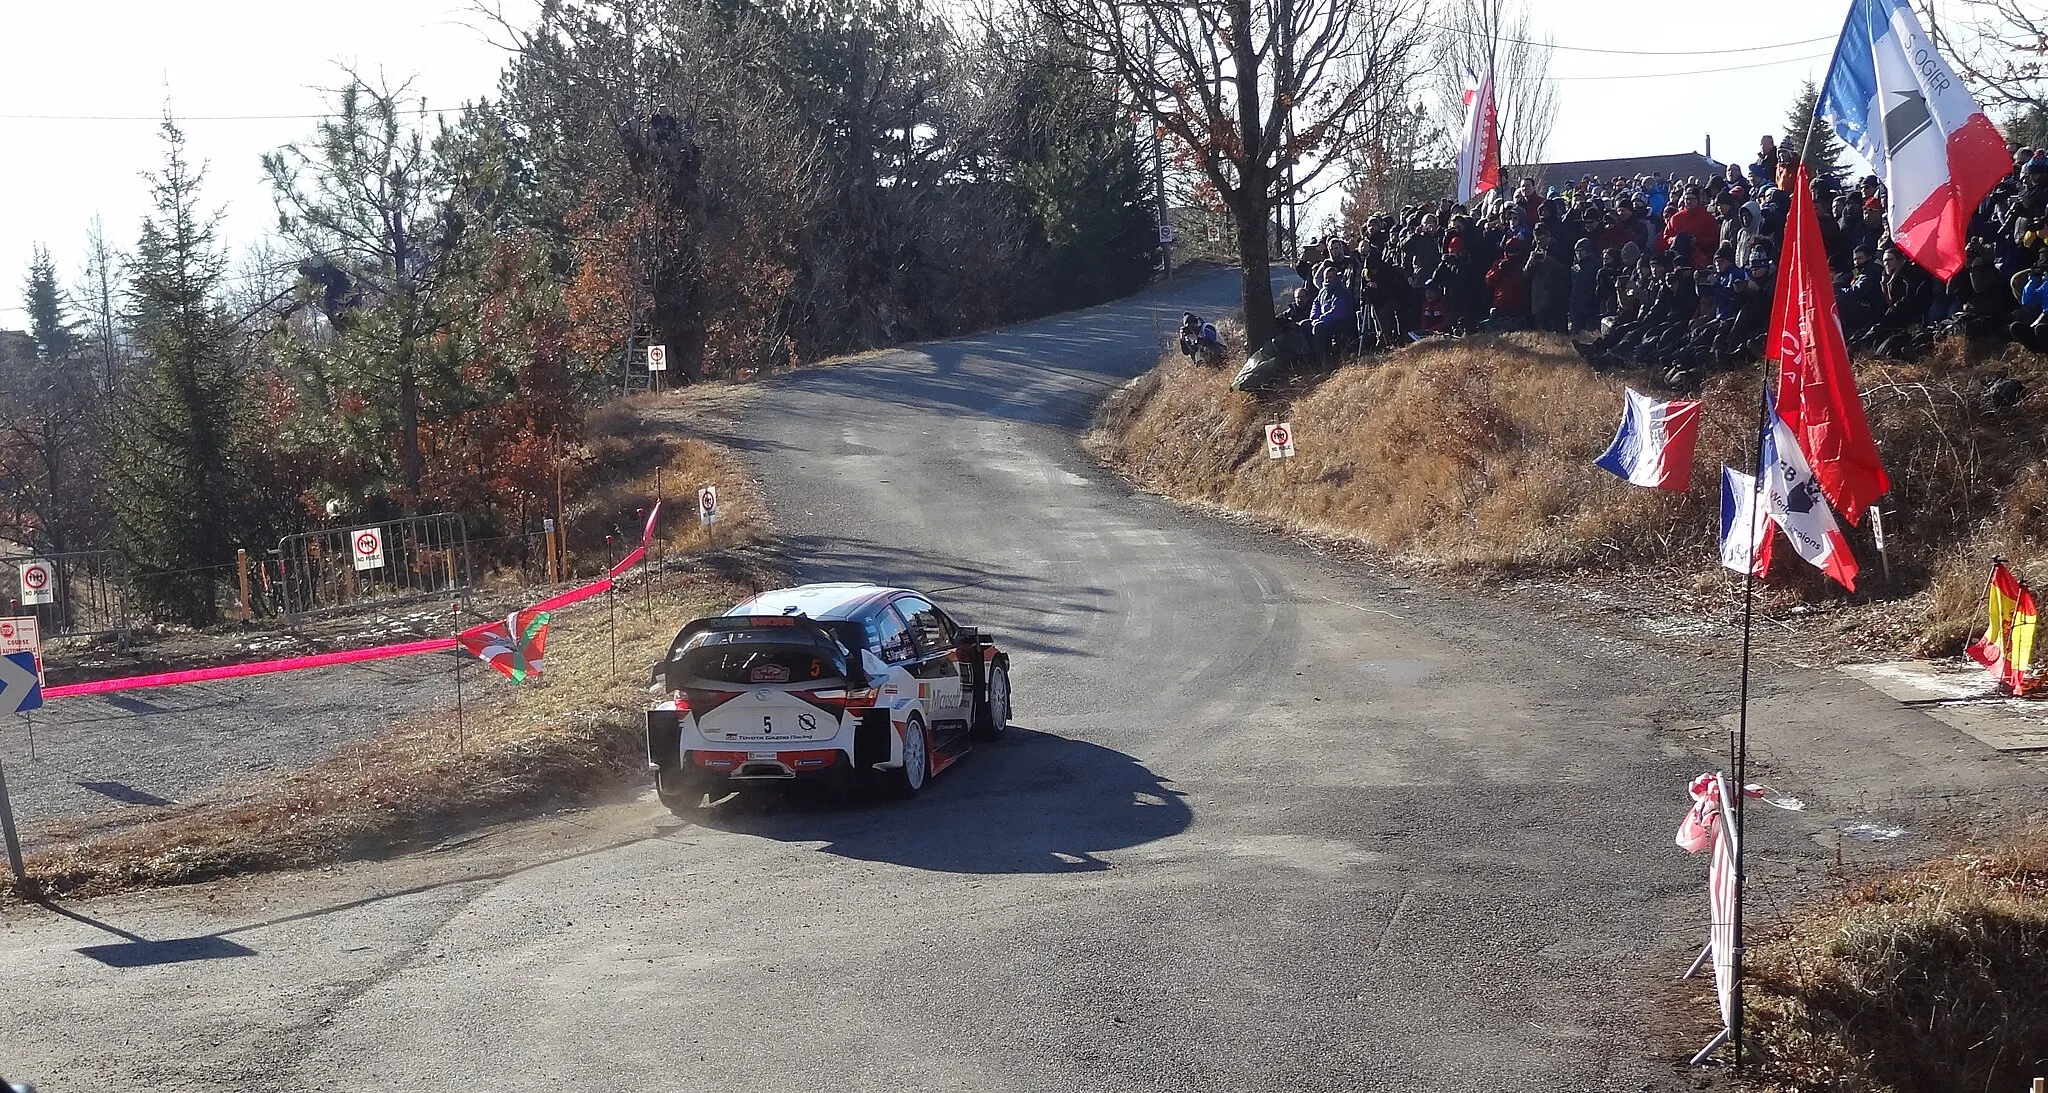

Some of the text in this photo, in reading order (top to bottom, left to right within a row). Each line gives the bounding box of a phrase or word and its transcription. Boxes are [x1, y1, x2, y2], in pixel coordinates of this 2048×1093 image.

[1904, 33, 1950, 96] S. OGIER
[810, 659, 822, 677] 5
[763, 716, 772, 734] 5
